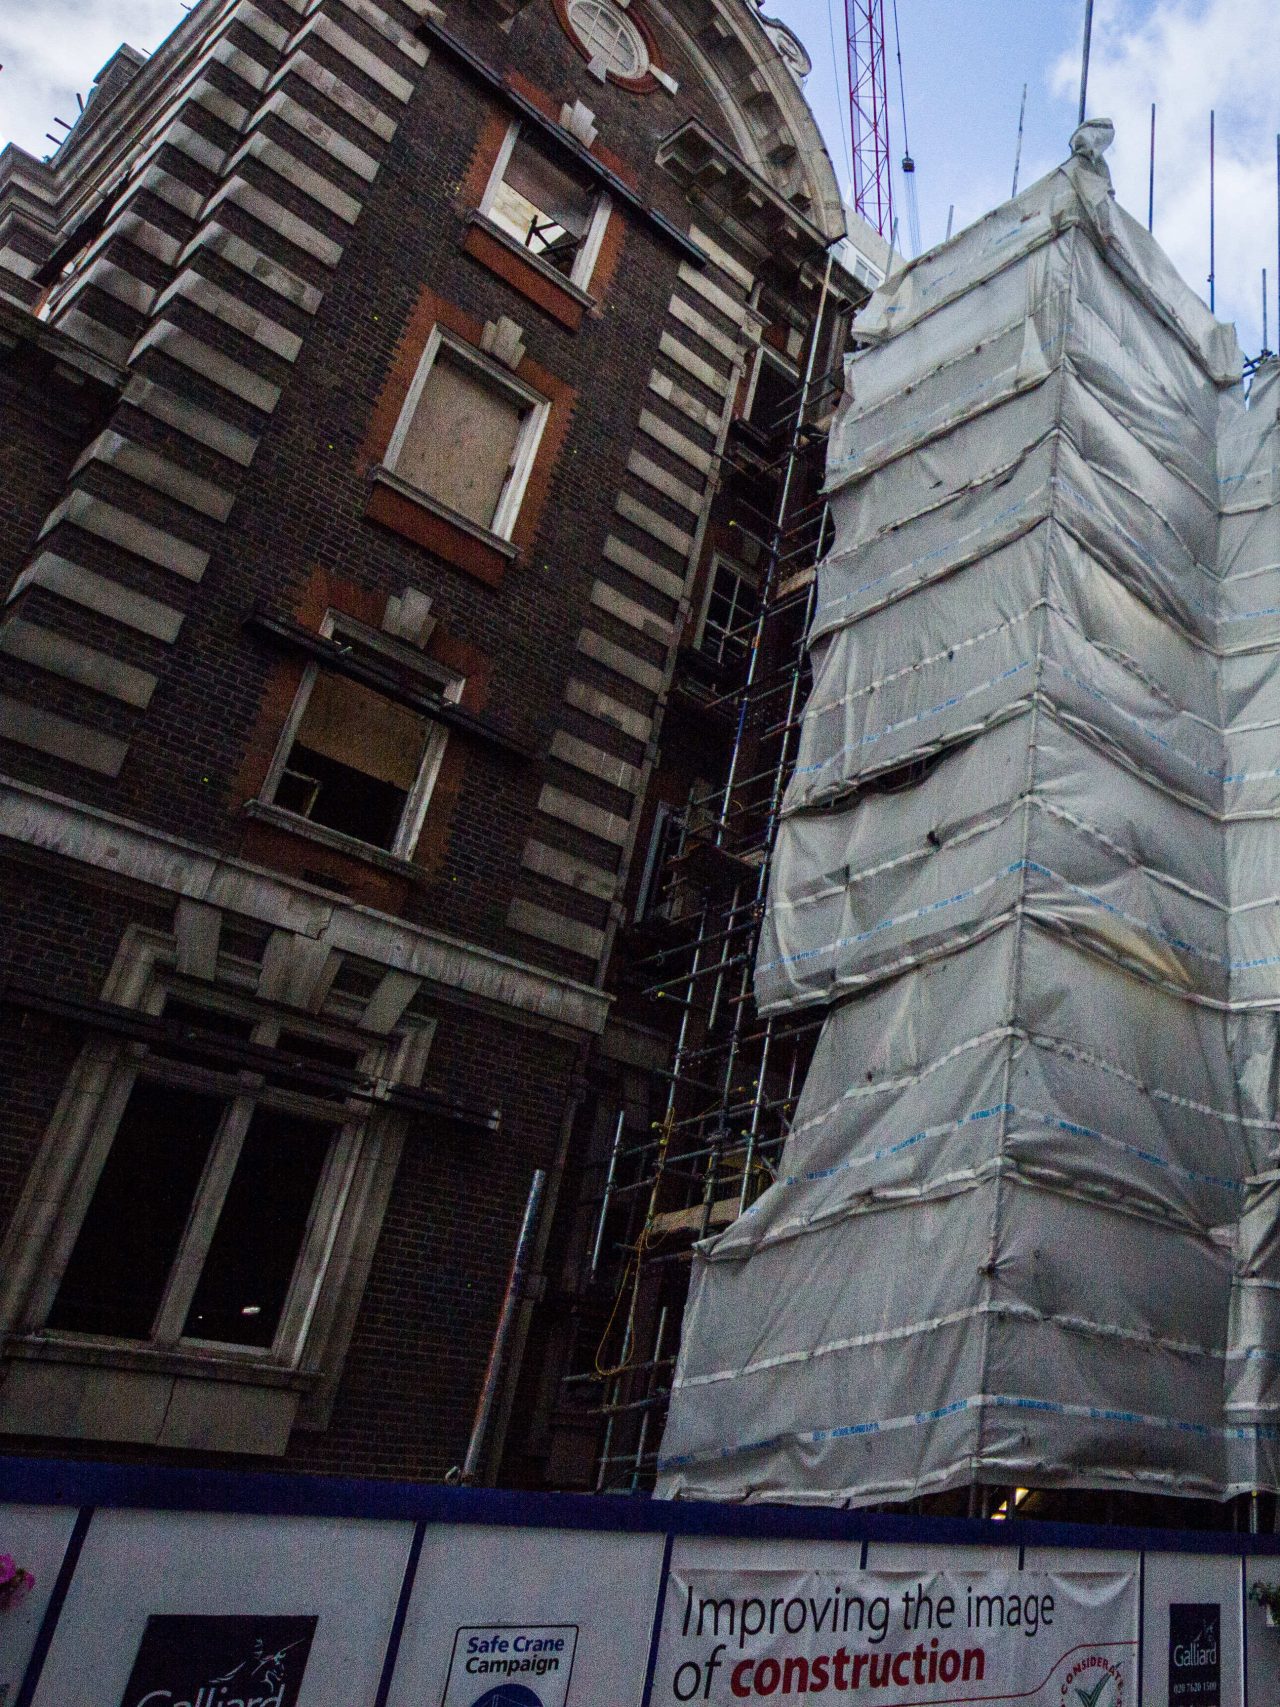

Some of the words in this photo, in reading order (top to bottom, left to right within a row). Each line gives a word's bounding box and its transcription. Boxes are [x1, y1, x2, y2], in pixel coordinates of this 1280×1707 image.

[682, 1585, 890, 1648] Improving
[902, 1583, 955, 1628] the
[967, 1586, 1055, 1636] image
[467, 1635, 509, 1653] Safe
[513, 1636, 564, 1652] Crane
[1173, 1642, 1217, 1667] Galliard
[466, 1654, 559, 1676] Campaign
[672, 1644, 726, 1701] of
[731, 1638, 985, 1698] construction
[1061, 1656, 1124, 1695] CONSIDERATE
